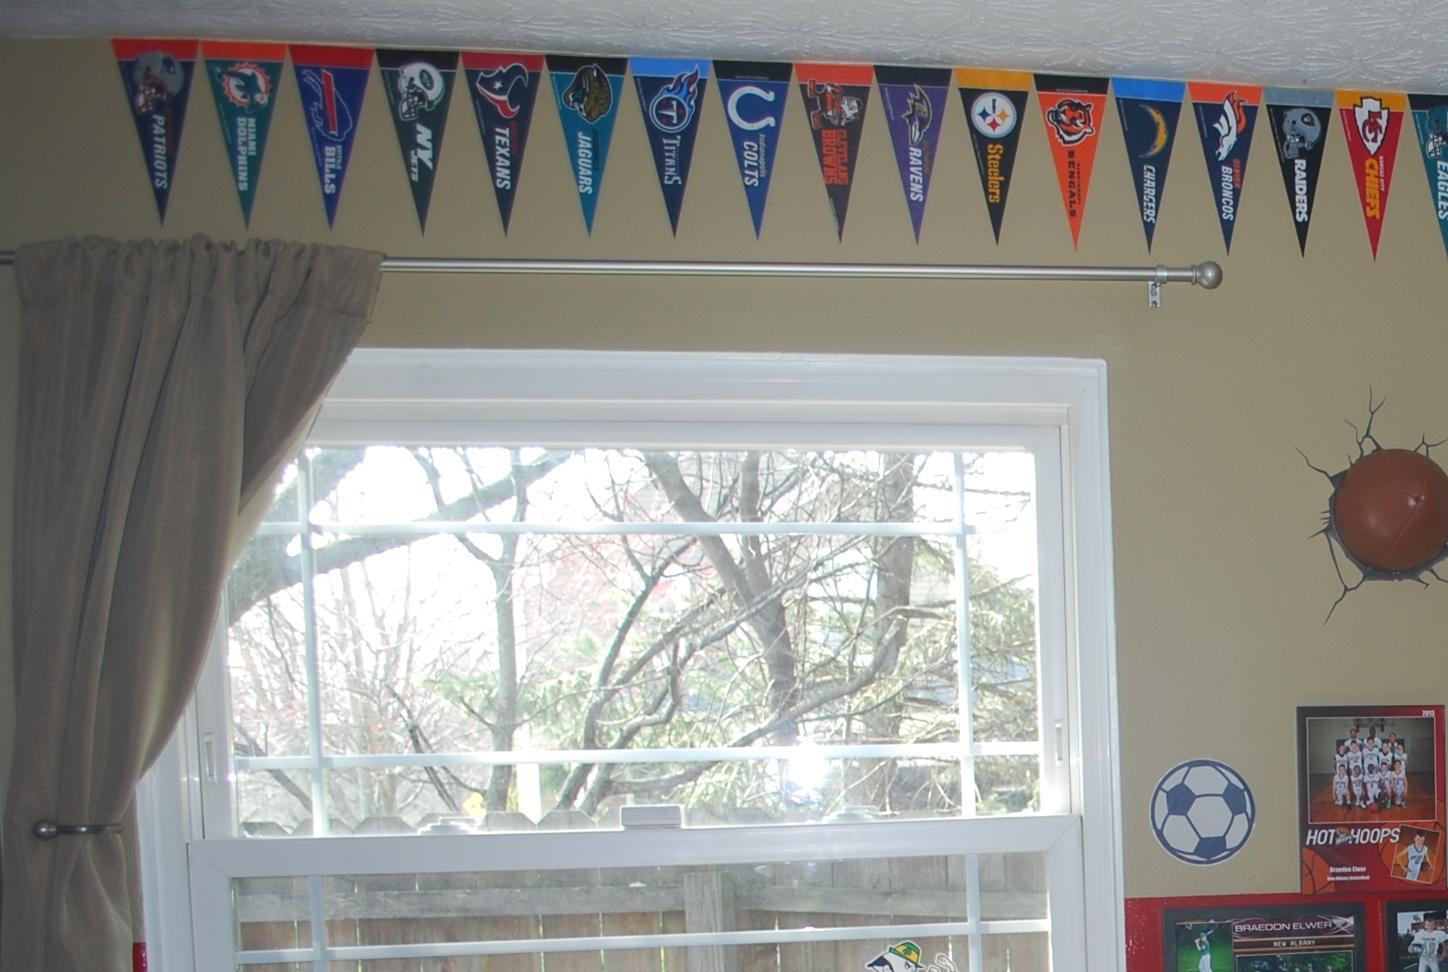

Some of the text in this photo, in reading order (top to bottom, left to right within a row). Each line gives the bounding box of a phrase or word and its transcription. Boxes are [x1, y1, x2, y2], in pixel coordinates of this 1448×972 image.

[153, 114, 167, 190] PATRIOTS
[237, 117, 249, 192] DOLPHINS
[248, 117, 256, 157] MIAMI
[415, 123, 433, 171] NY
[494, 127, 511, 190] TEXANS
[577, 131, 592, 195] JAGUARS
[744, 141, 758, 188] COLTS
[821, 129, 836, 186] BROWNS
[325, 146, 336, 195] BILLS
[410, 149, 420, 183] JETS
[909, 147, 923, 203] RAVENS
[988, 143, 1003, 205] Steelers
[1067, 150, 1076, 218] BENGALS
[1221, 165, 1233, 221] BRONCOS
[1294, 159, 1307, 223] RAIDERS
[1365, 158, 1380, 220] CHIEFS
[1144, 165, 1156, 225] CHARGERS
[1305, 829, 1336, 846] HOT
[1349, 828, 1400, 845] HOOPS
[1234, 921, 1332, 933] BRAEDON ELWER
[1289, 939, 1316, 947] ALBANY
